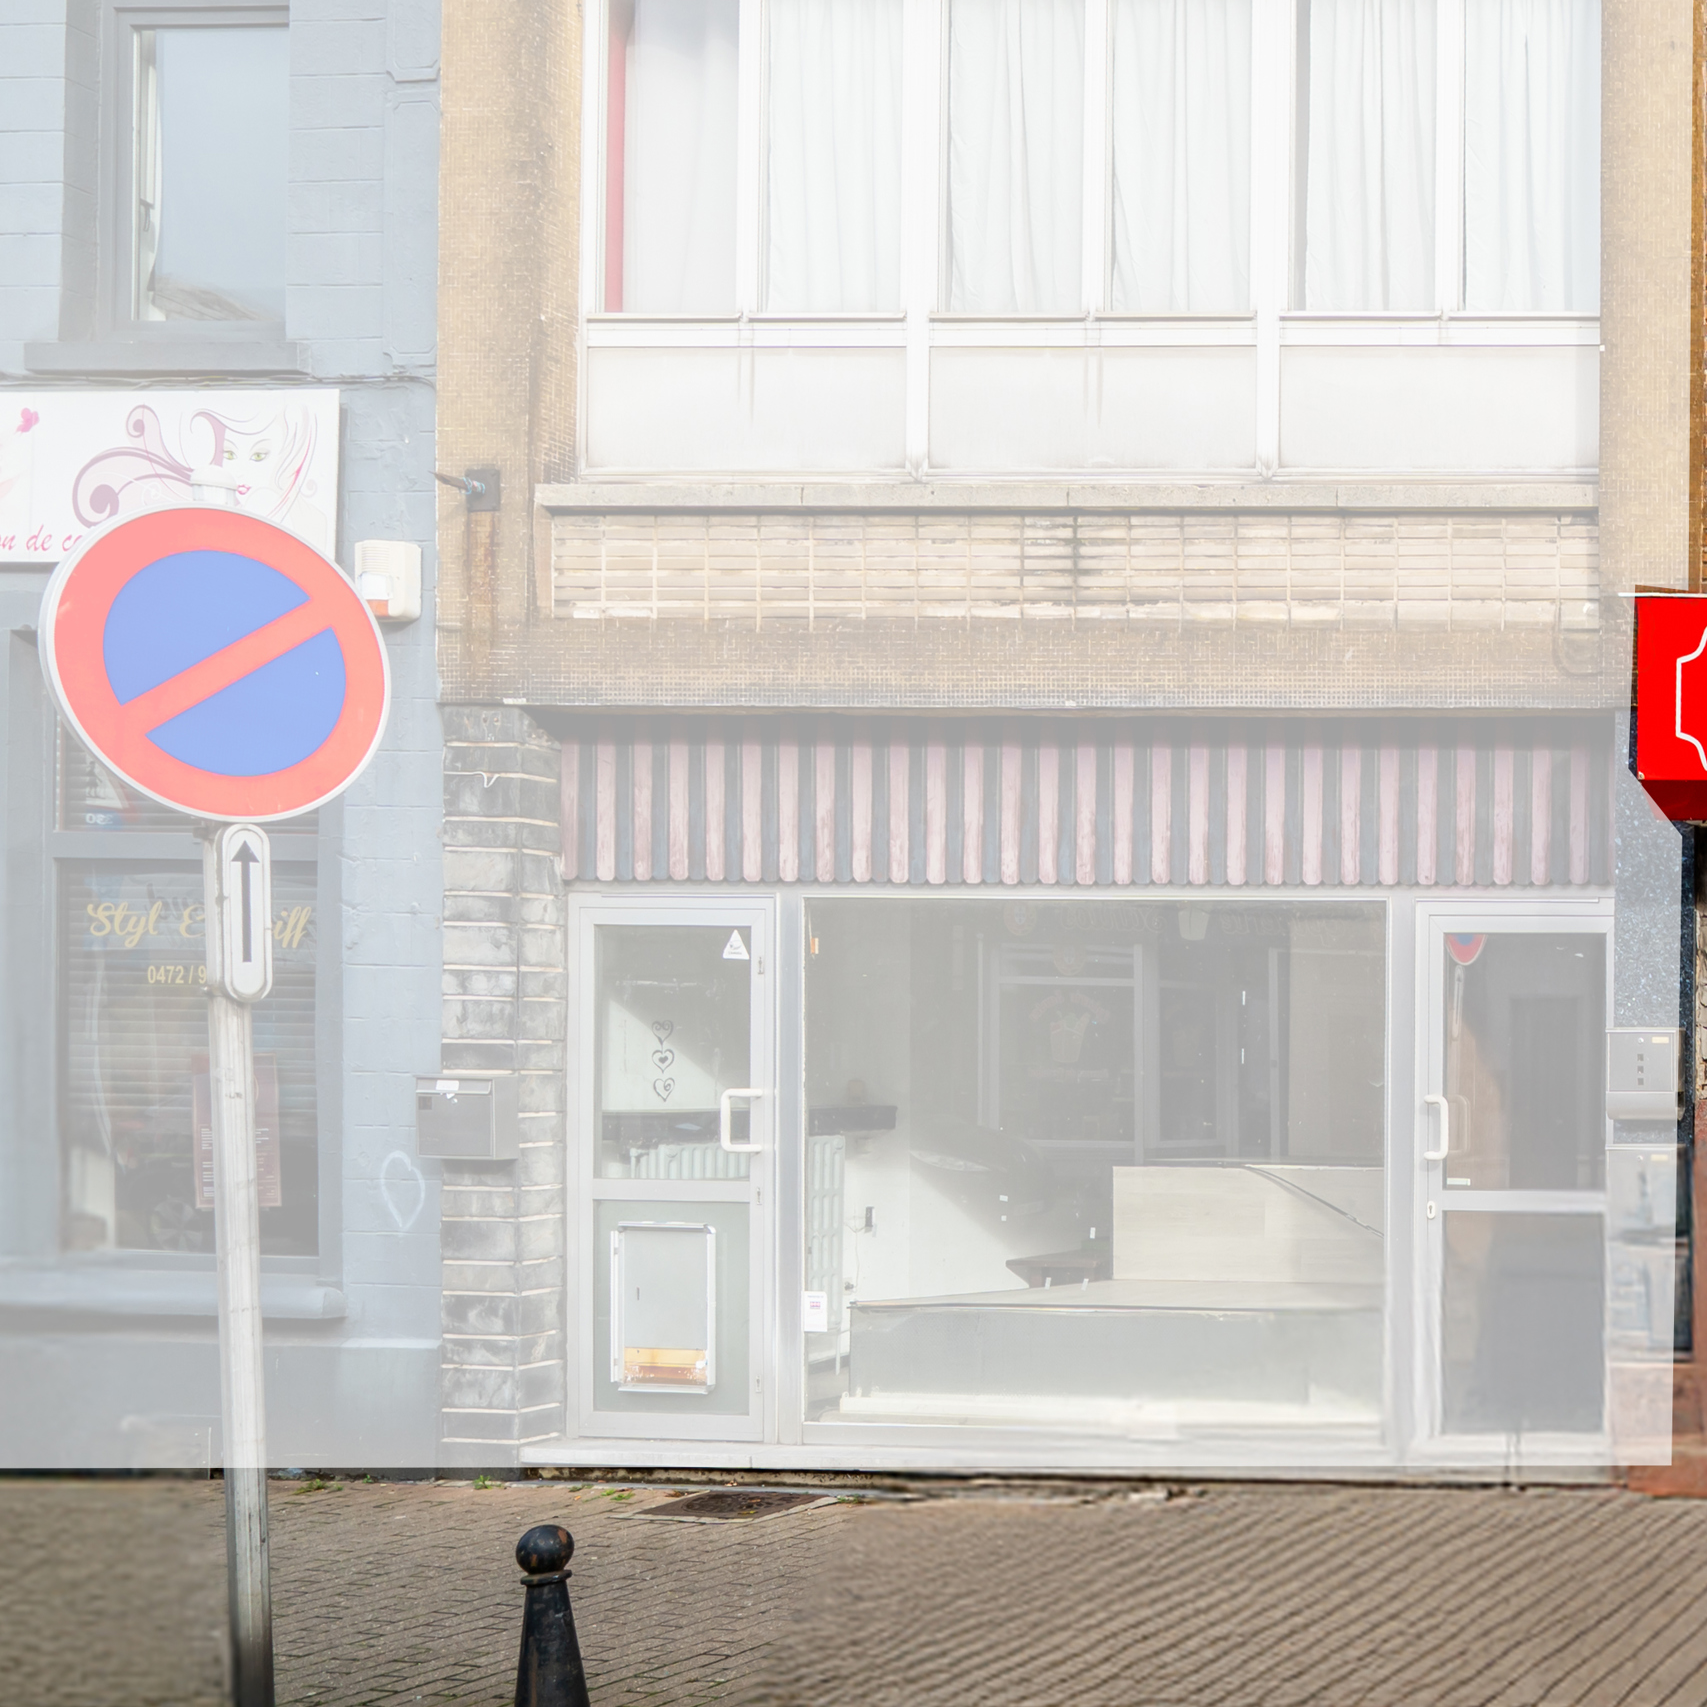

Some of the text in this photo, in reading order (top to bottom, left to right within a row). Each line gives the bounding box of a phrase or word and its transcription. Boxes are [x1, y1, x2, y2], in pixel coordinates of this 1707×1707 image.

[26, 524, 52, 552] de
[87, 901, 162, 948] Styl
[147, 965, 184, 984] 0472
